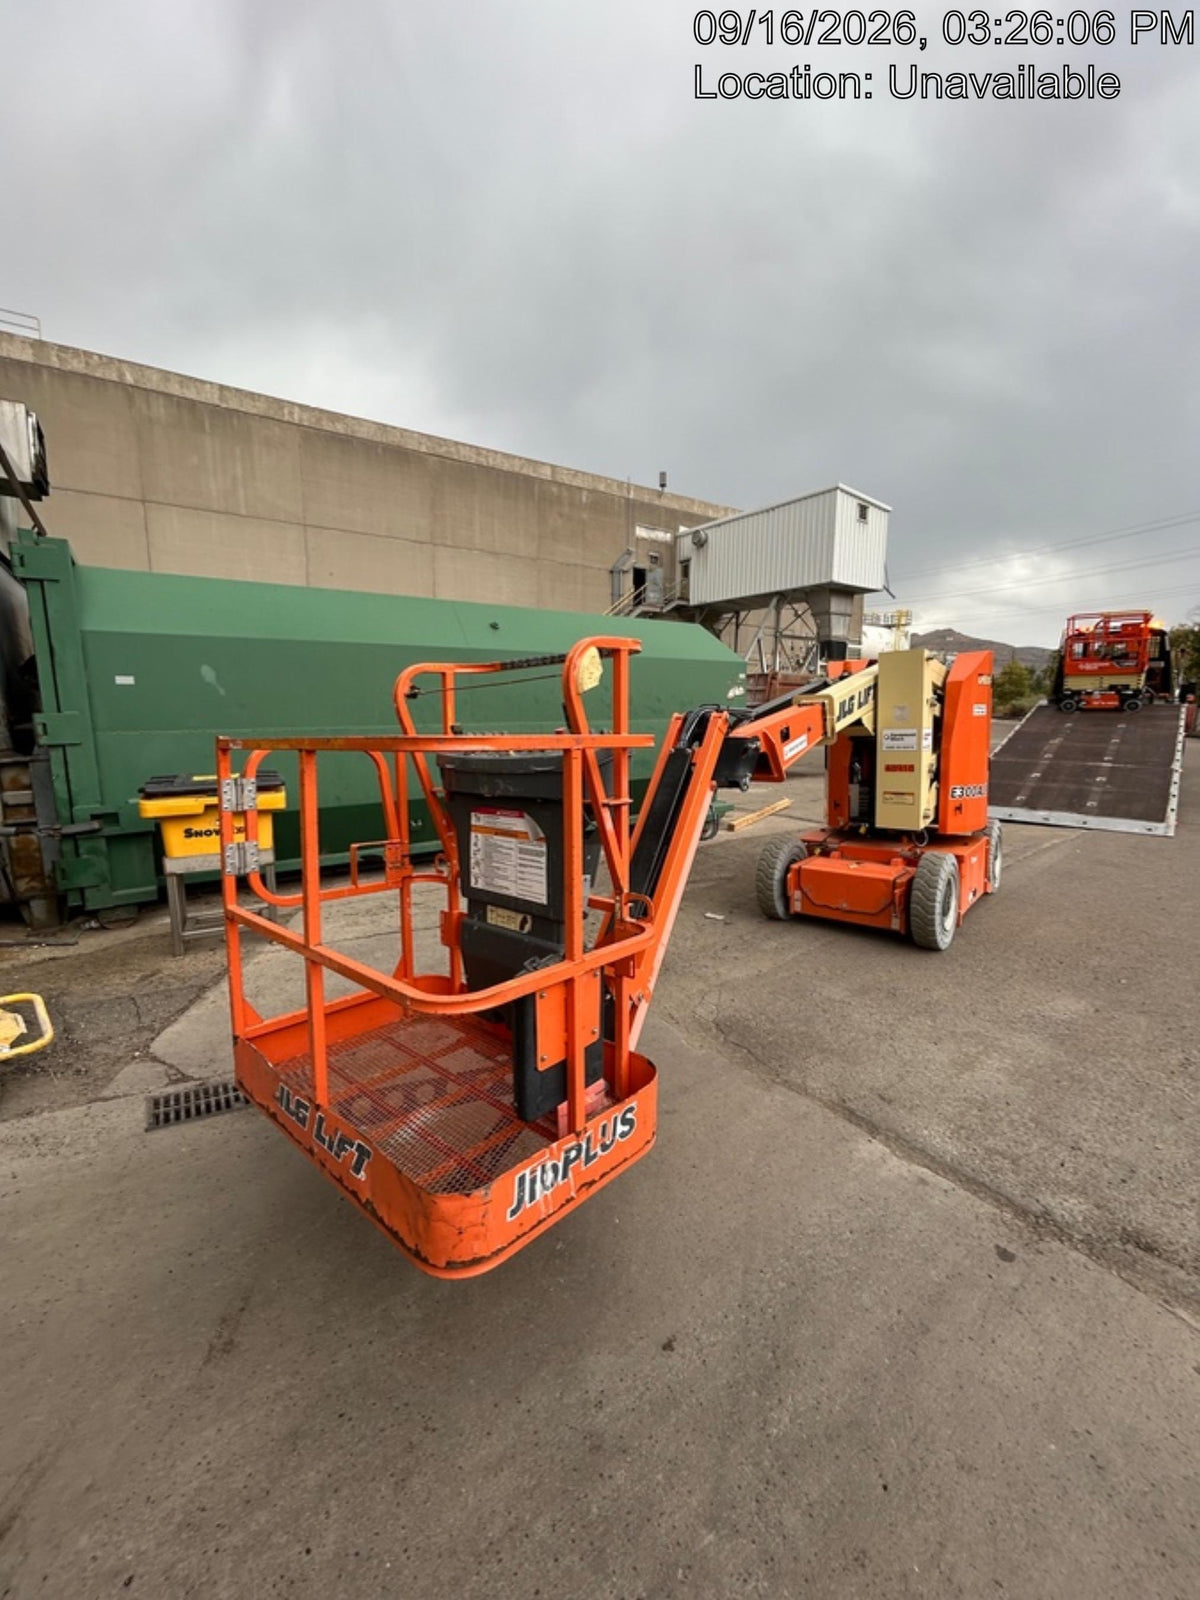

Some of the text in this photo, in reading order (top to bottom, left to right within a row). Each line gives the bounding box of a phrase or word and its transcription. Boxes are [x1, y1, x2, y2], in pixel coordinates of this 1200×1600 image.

[836, 684, 875, 722] JLG LIF
[275, 1083, 311, 1131] JLG
